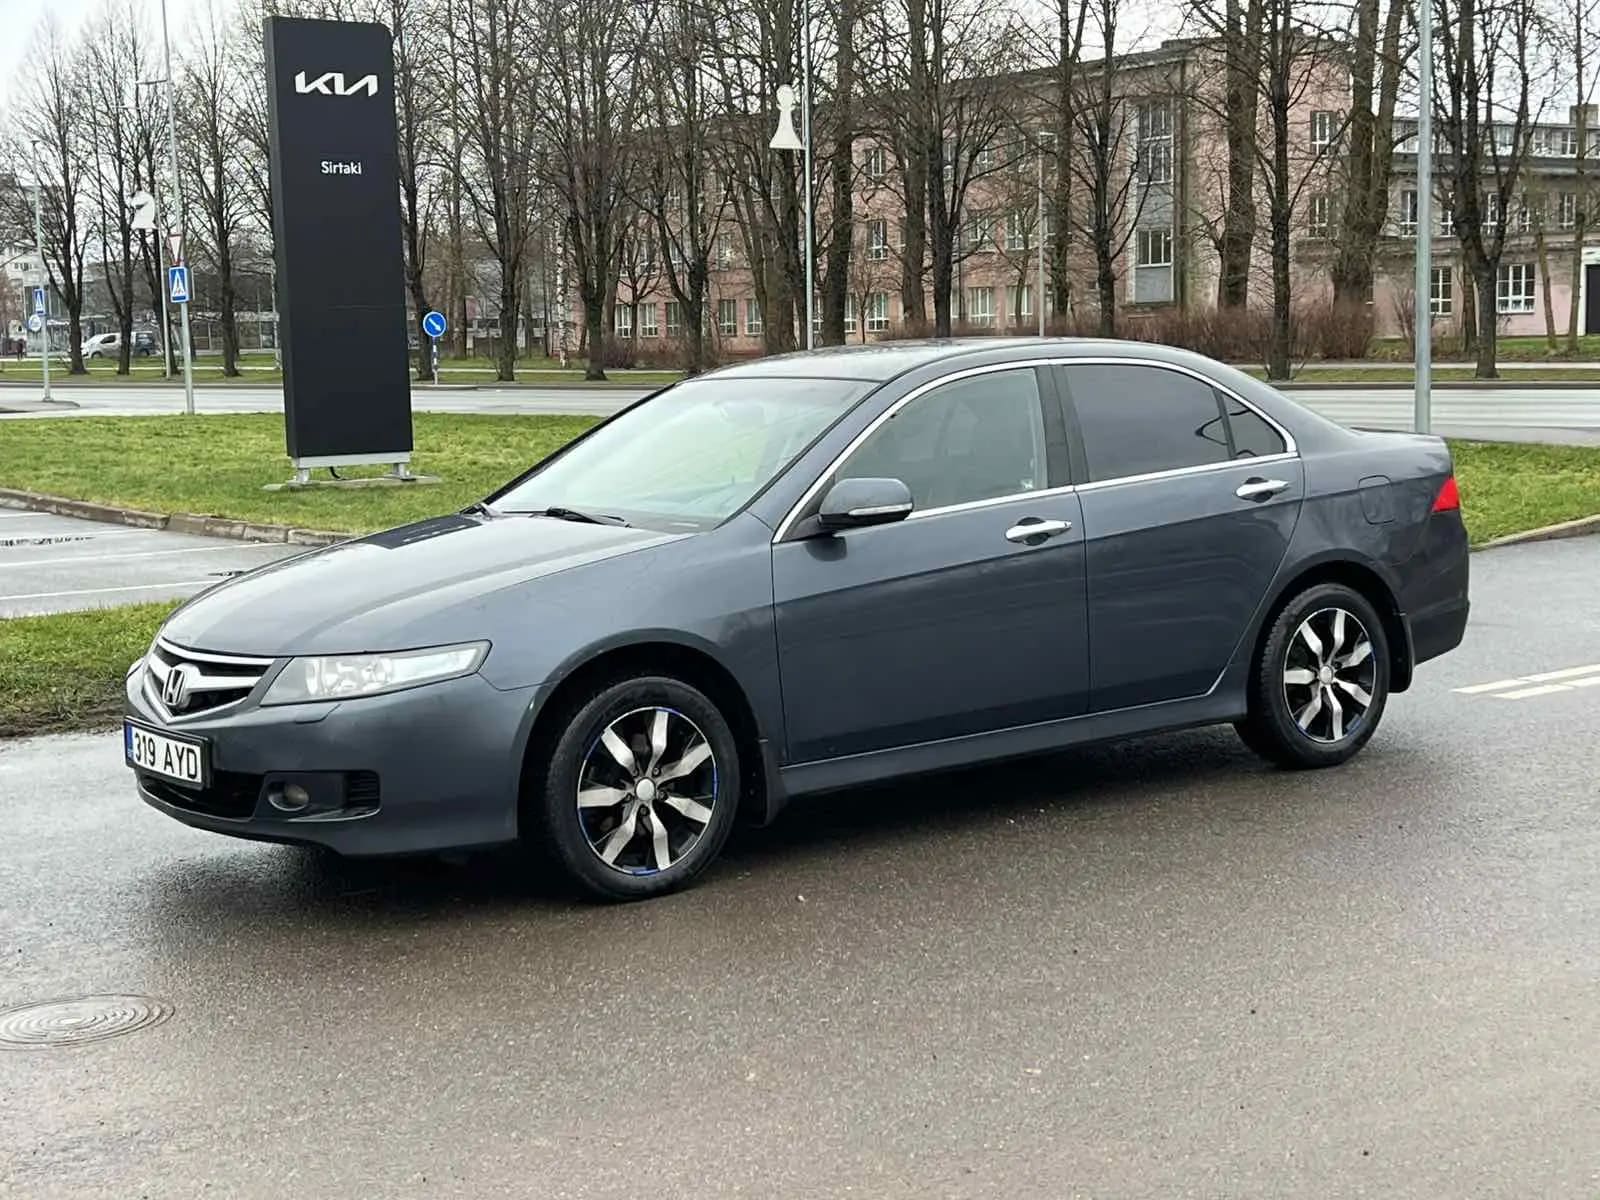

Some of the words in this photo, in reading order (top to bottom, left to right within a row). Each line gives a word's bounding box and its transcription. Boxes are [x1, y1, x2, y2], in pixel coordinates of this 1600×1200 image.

[295, 71, 378, 97] KIA
[320, 160, 363, 175] Sirtaki
[134, 732, 156, 767] 319
[163, 742, 198, 780] AYD
